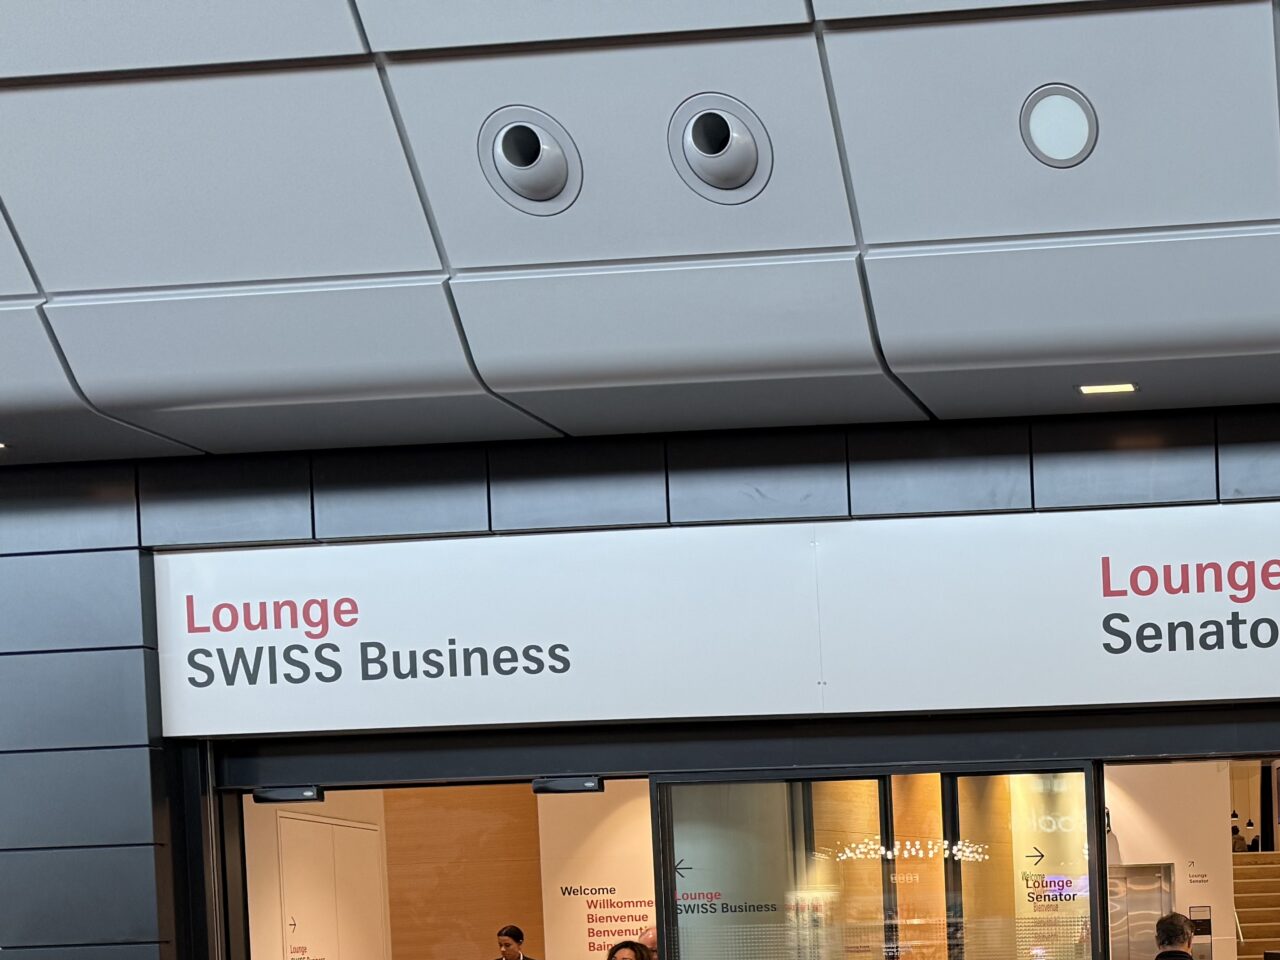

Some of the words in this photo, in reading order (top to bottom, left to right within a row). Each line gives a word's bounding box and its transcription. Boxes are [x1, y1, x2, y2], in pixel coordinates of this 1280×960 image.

[185, 594, 360, 639] Lounge
[187, 643, 342, 689] SWISS
[360, 638, 571, 682] Business
[560, 885, 616, 896] Welcome
[1025, 878, 1073, 891] Lounge
[674, 890, 721, 902] Lounge
[1027, 891, 1077, 902] Senator
[676, 902, 717, 915] SWISS
[721, 902, 777, 914] Business
[587, 913, 648, 924] Bienvenue
[588, 926, 647, 938] Benvenut
[290, 945, 307, 956] Lounge
[588, 941, 616, 951] Bain
